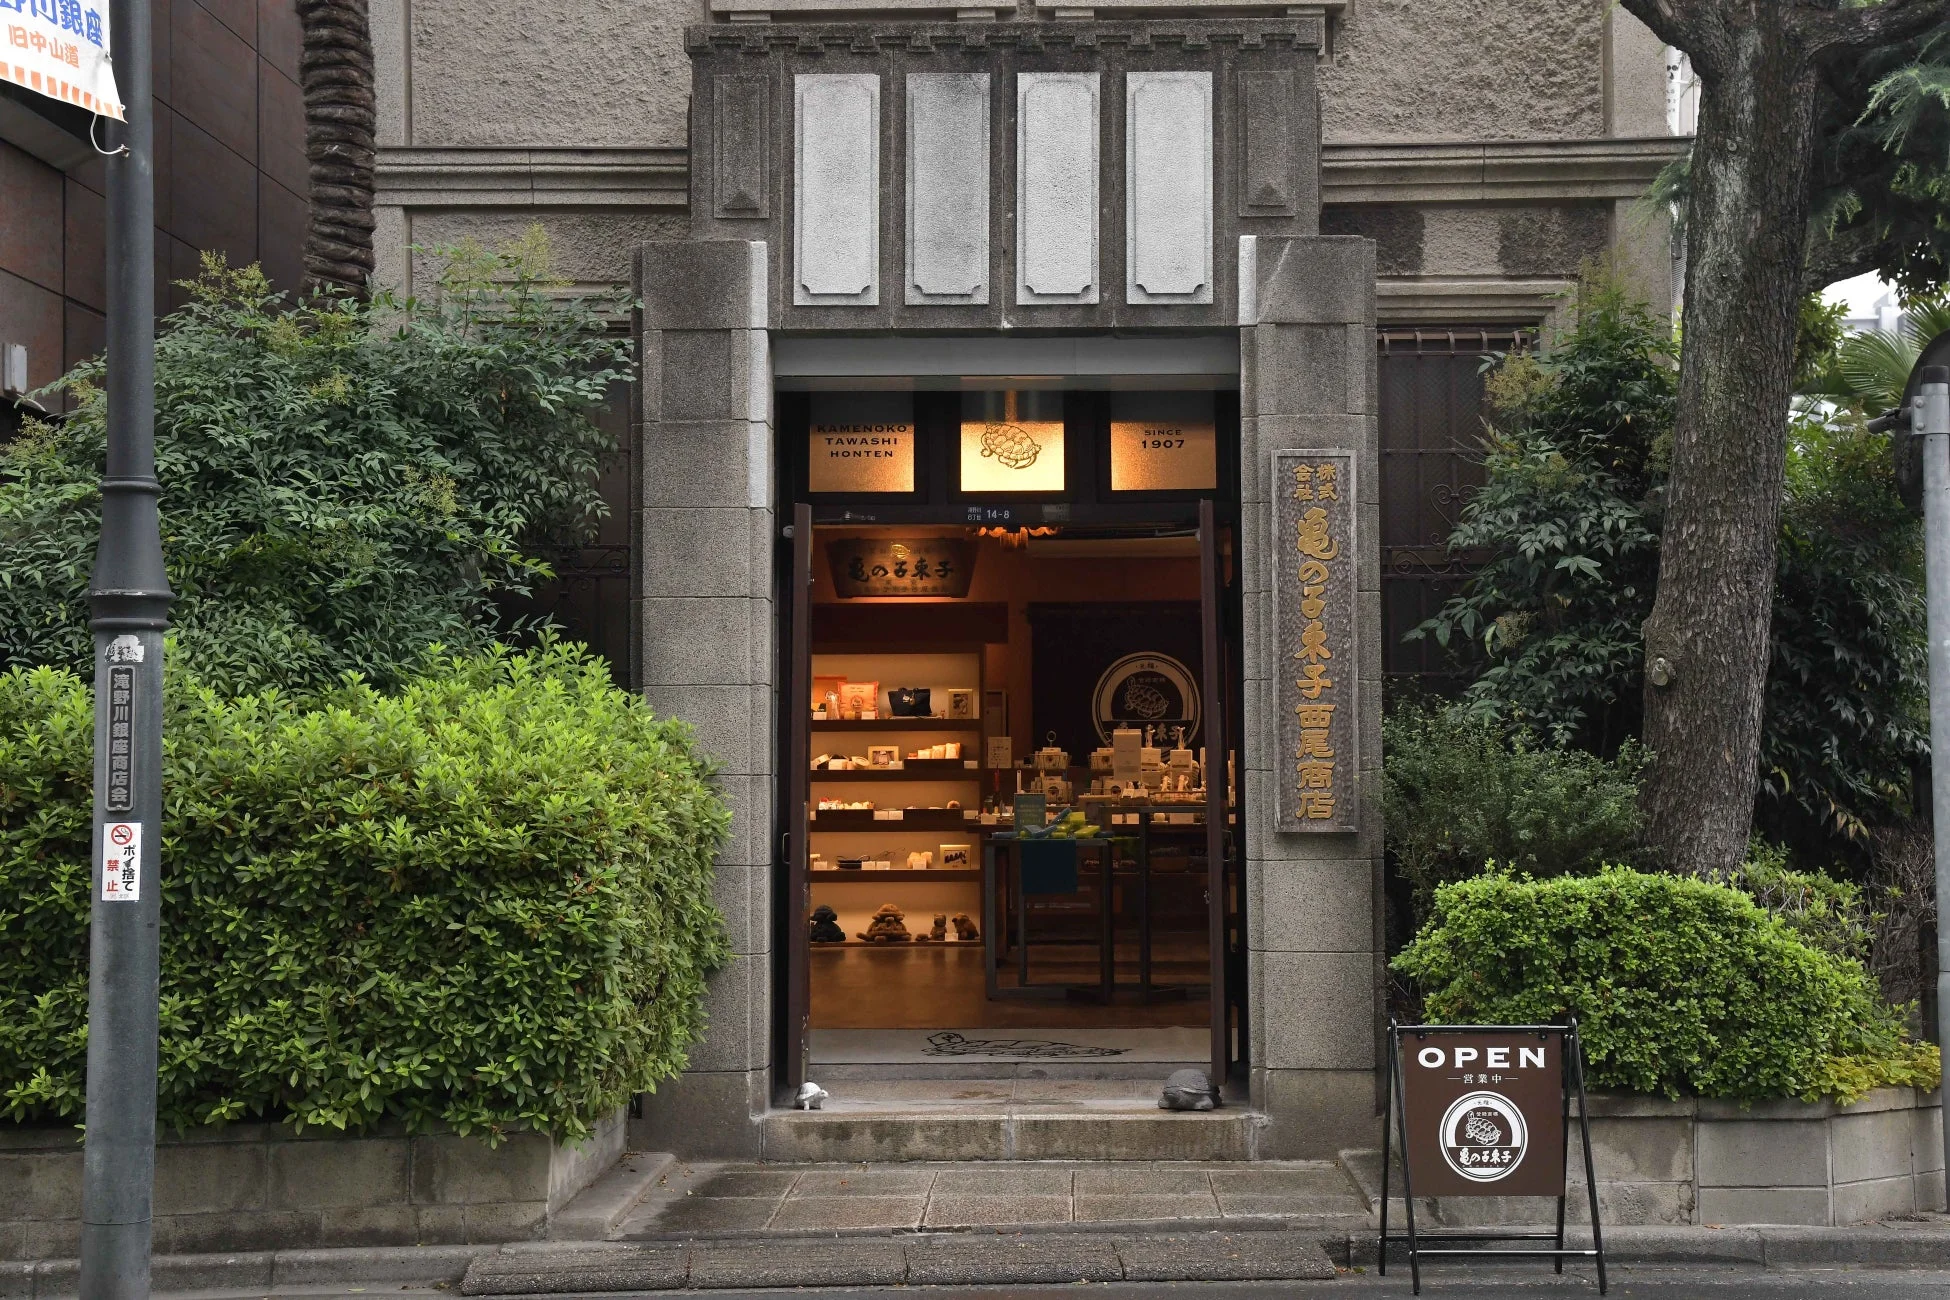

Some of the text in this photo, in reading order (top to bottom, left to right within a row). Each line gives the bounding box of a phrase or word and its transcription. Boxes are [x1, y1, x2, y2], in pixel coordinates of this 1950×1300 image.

[0, 0, 103, 48] 川銀座
[8, 24, 79, 68] 旧中山道
[817, 424, 907, 433] KAMENOKO
[825, 437, 898, 445] TAWASHI
[1141, 439, 1185, 449] 1907
[830, 450, 893, 458] HONTEN
[1293, 463, 1338, 501] 株式 会社
[986, 509, 1010, 519] 14-8
[1293, 506, 1339, 820] 亀の子束子西尾商店
[111, 673, 130, 803] 滝野川銀座商店会
[106, 859, 120, 892] 禁止
[122, 844, 136, 892] ポイ捨て
[1418, 1047, 1545, 1068] OPEN
[1463, 1073, 1502, 1084] 営業中
[1459, 1147, 1512, 1165] 亀の子束子
